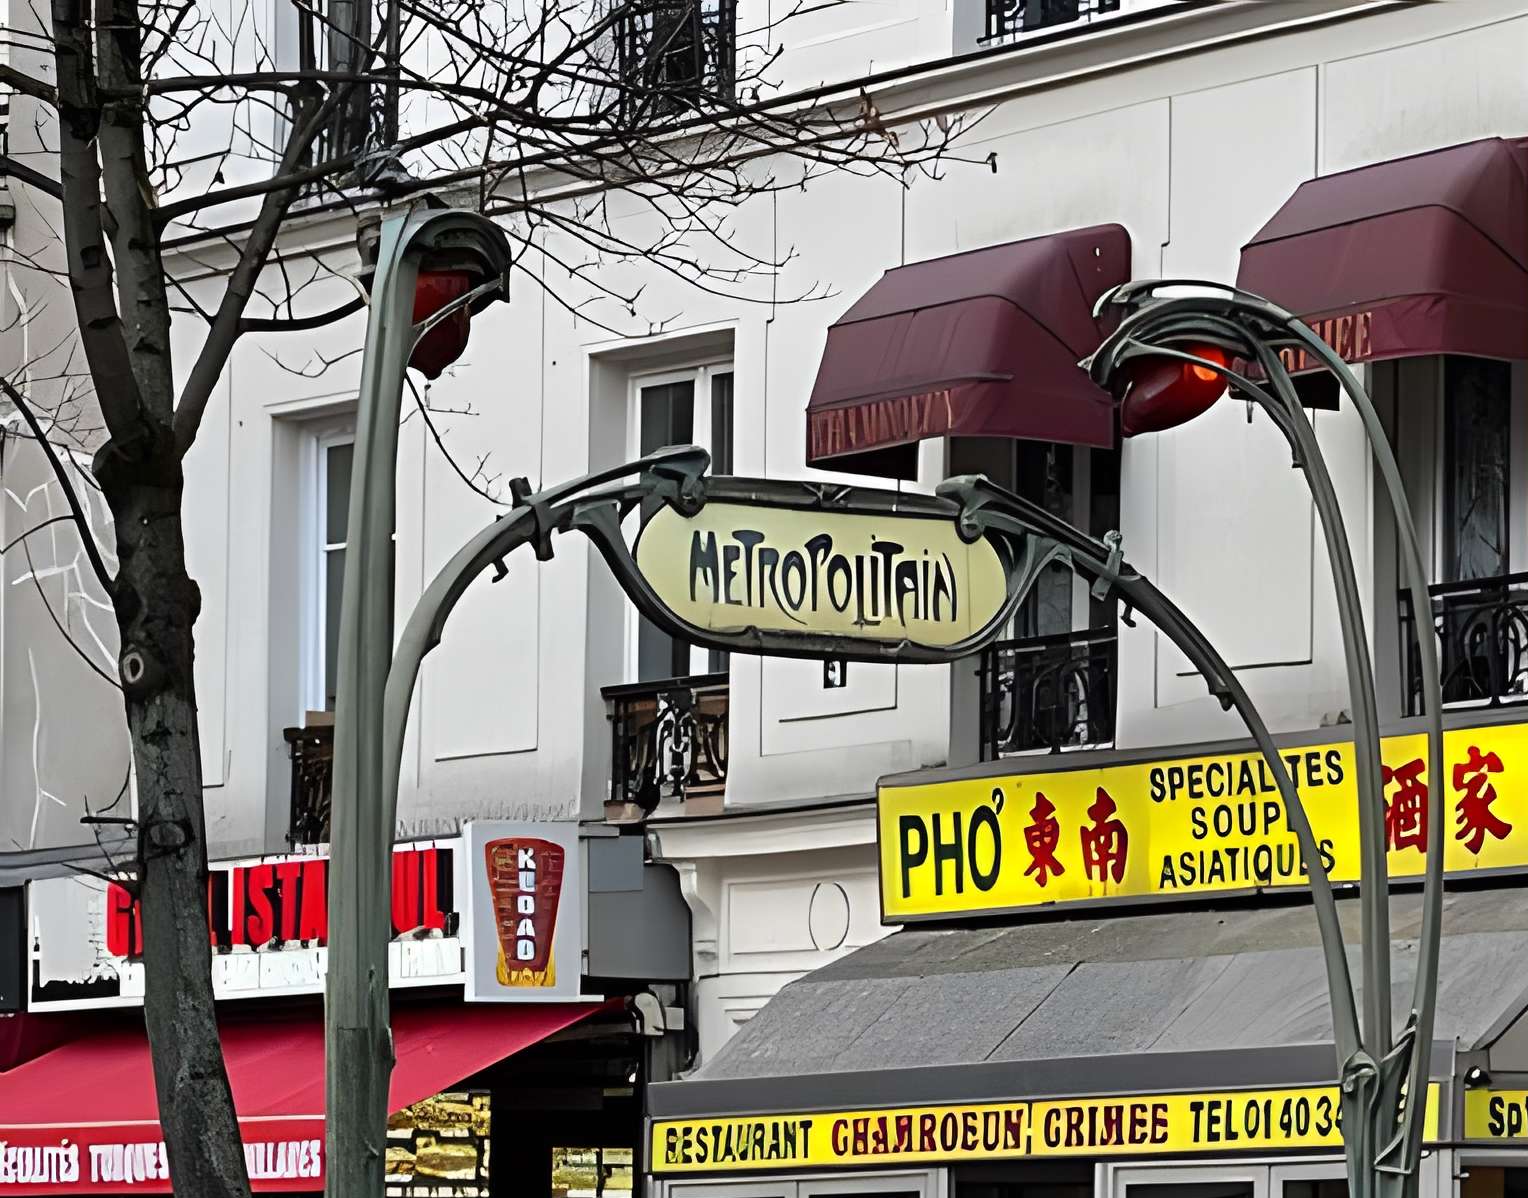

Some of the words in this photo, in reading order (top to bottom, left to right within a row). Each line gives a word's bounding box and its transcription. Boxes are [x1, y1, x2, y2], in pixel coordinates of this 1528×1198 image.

[690, 529, 957, 627] METROPOLITAIN
[1150, 750, 1344, 802] SPECIALTES
[1191, 802, 1299, 839] SOUP
[231, 848, 445, 948] ISTAUL
[665, 1119, 813, 1164] RESTAURANT
